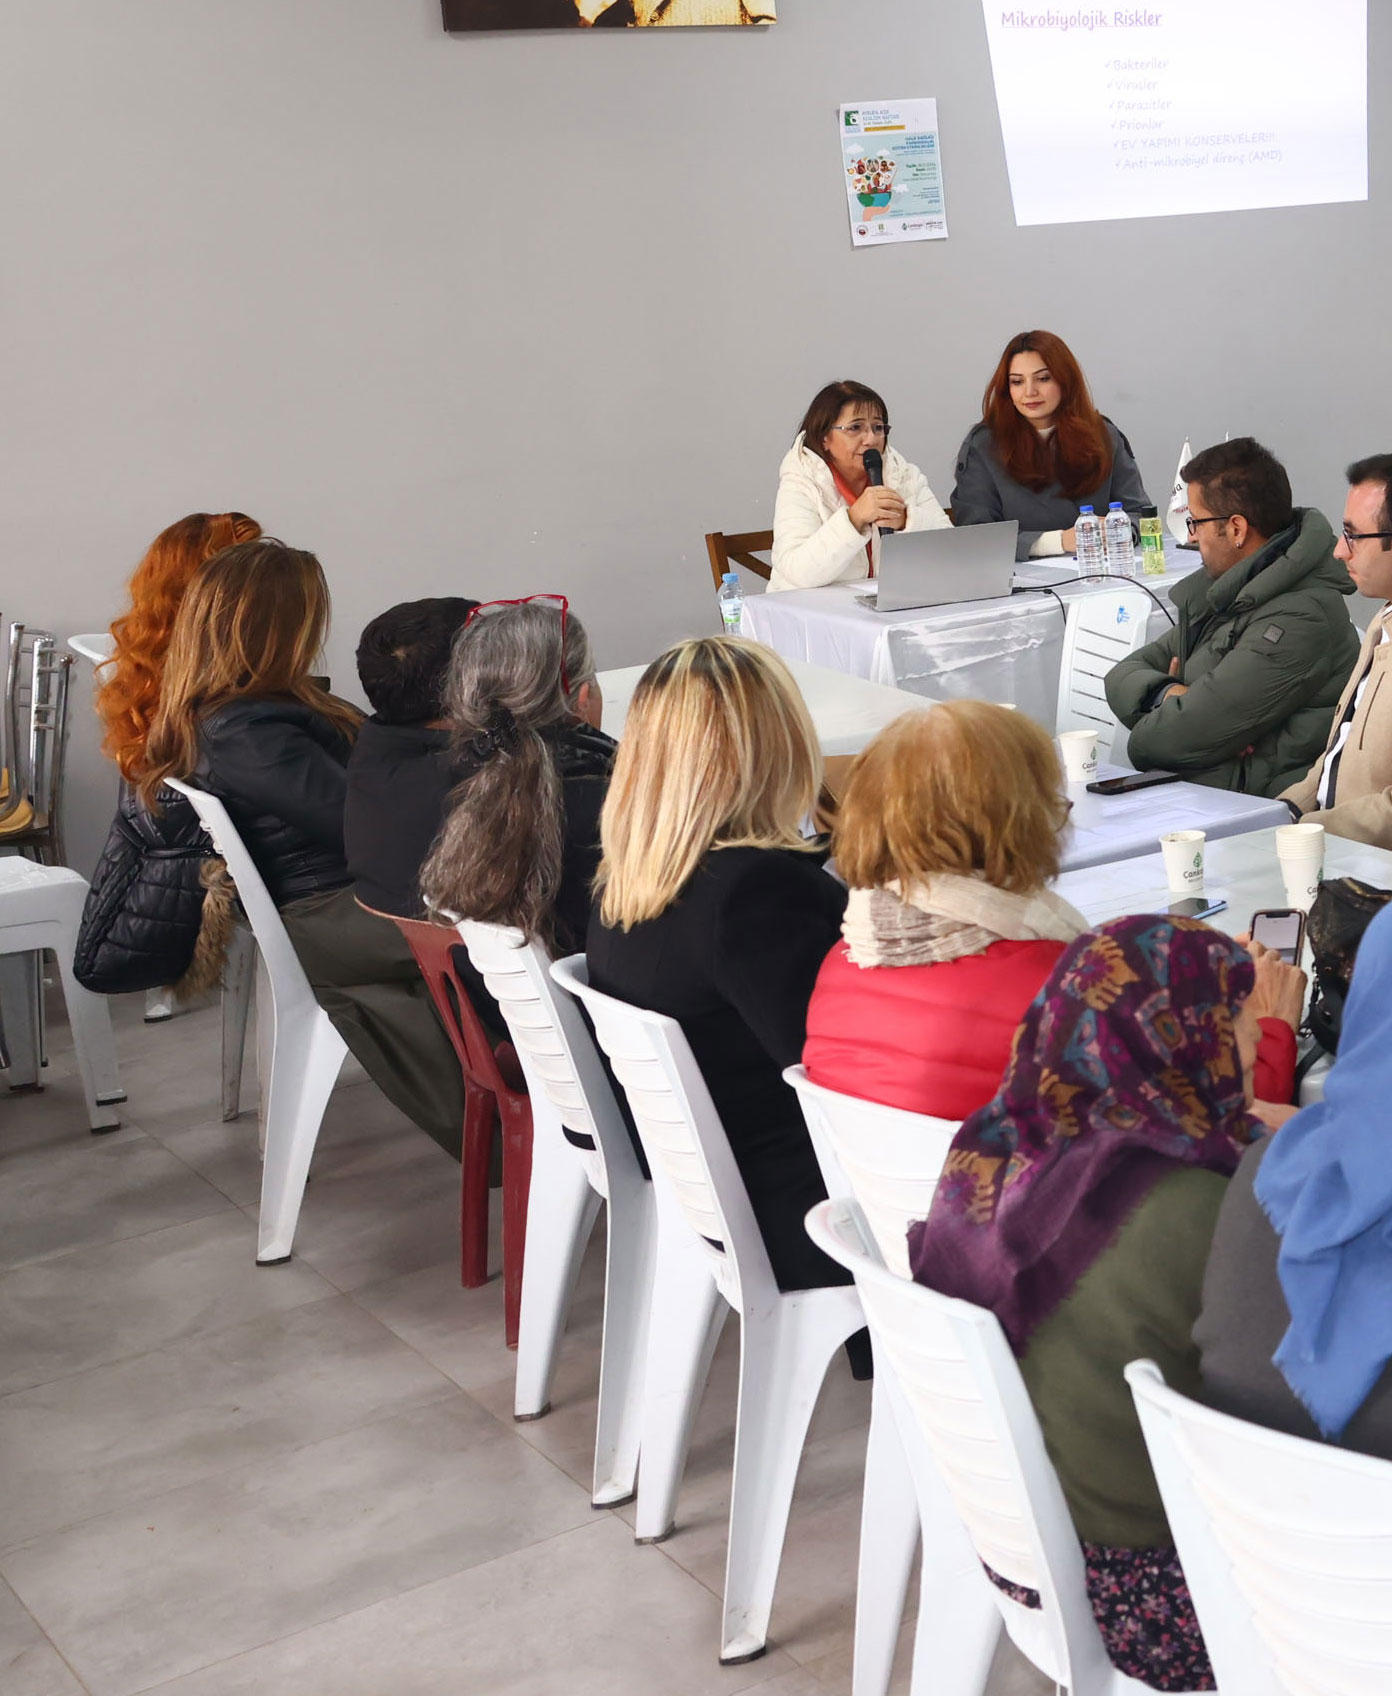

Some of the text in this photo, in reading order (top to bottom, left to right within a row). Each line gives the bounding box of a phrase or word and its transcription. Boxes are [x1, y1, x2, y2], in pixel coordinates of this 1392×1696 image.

[1001, 10, 1163, 31] Mikrobiyolojik Riskler
[1113, 57, 1168, 71] Bakteriler
[1117, 99, 1172, 111] Parazitler
[1119, 117, 1164, 130] Prionlar
[1121, 138, 1137, 151] EV
[1141, 136, 1181, 149] YAPIMI
